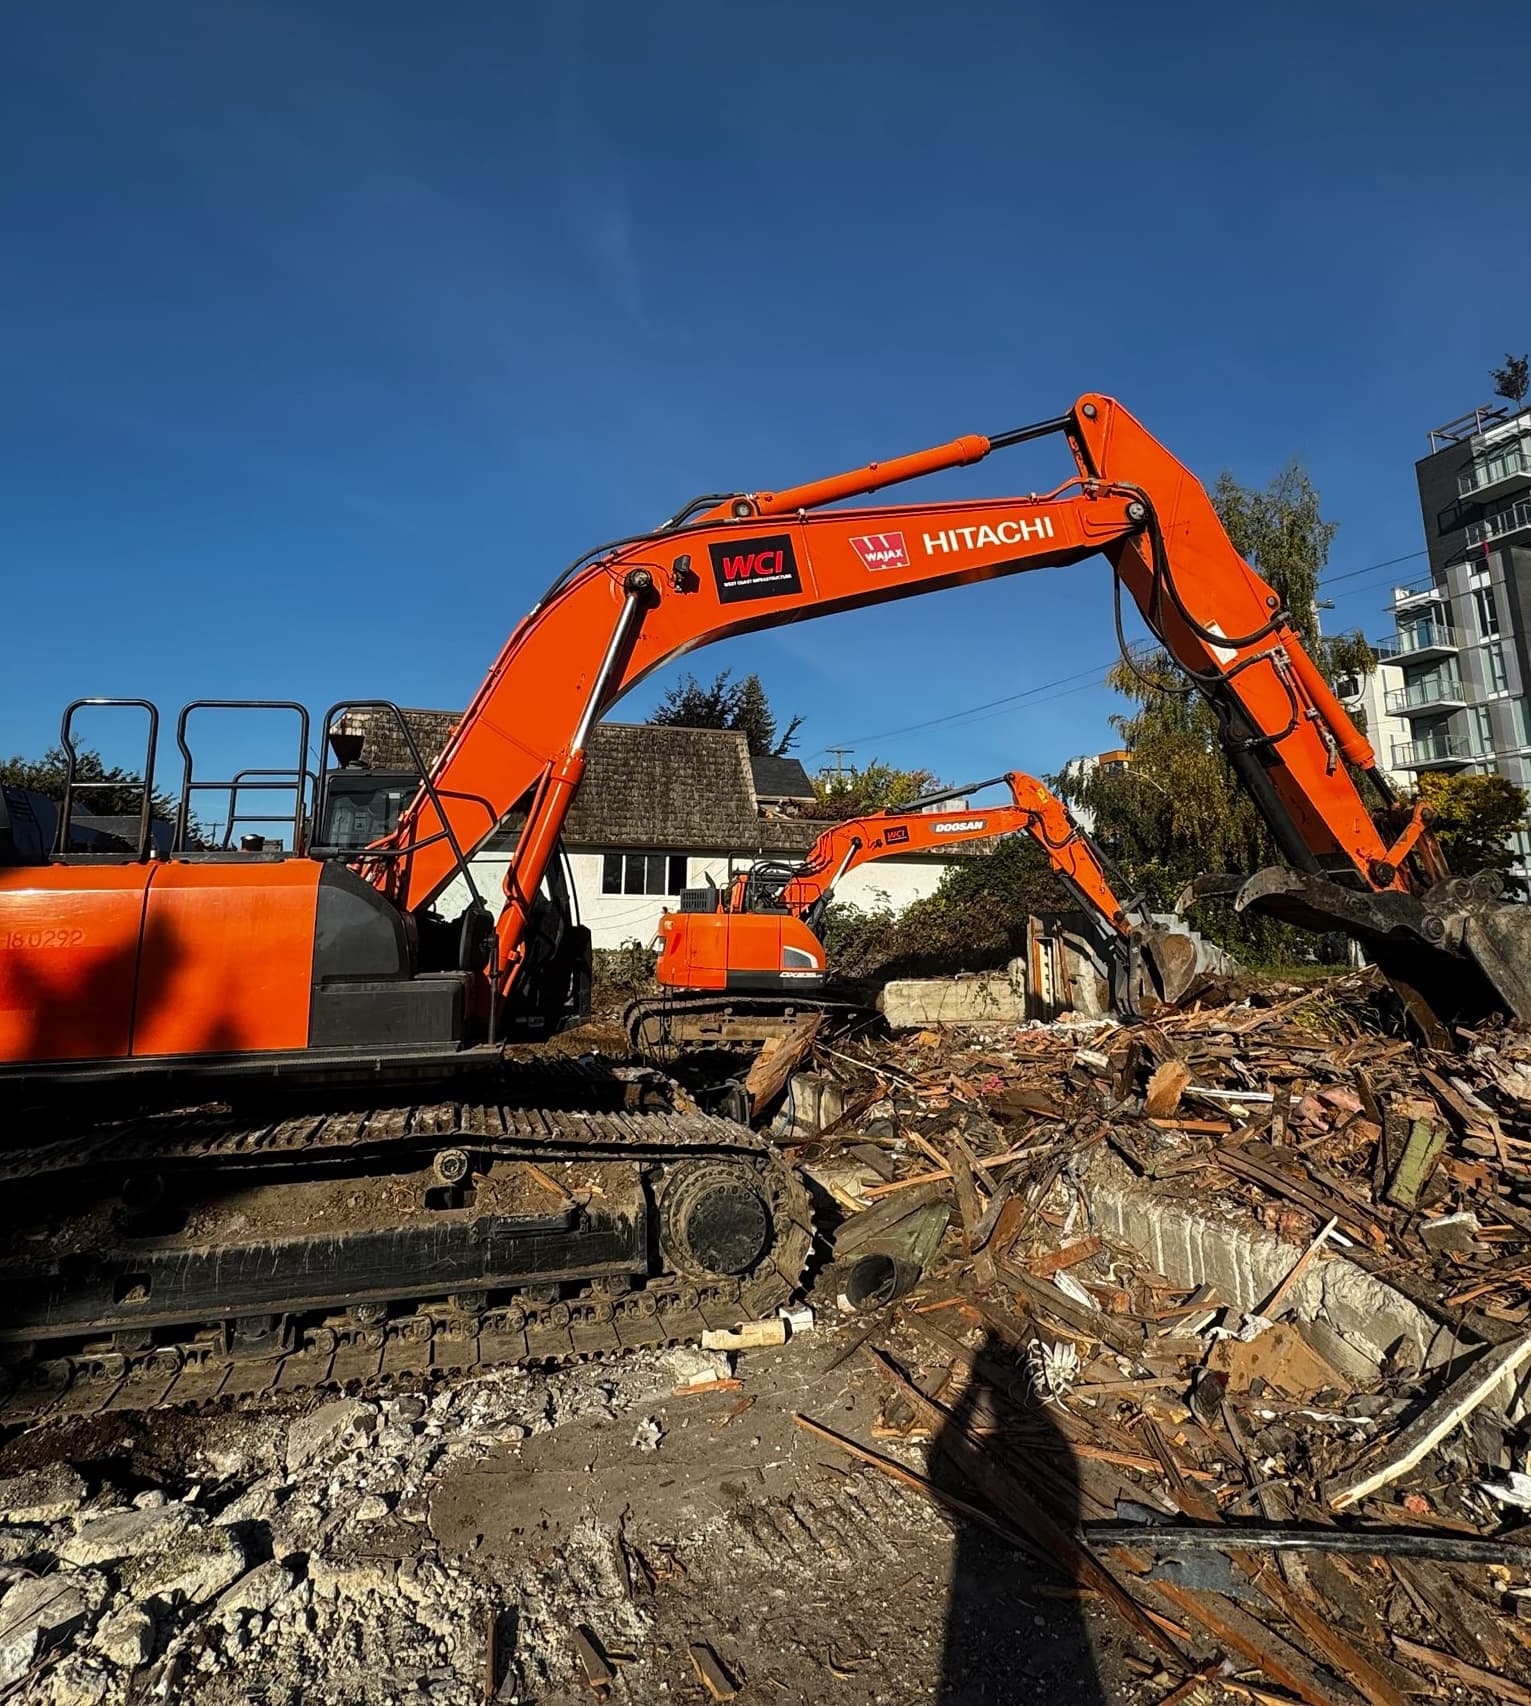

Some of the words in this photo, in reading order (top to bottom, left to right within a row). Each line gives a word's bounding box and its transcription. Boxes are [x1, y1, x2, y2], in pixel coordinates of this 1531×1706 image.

[923, 516, 1054, 555] HITACHI
[865, 548, 904, 562] WAJAX
[722, 550, 783, 580] WCI
[935, 821, 984, 832] DOOSAN
[887, 829, 905, 840] WCI
